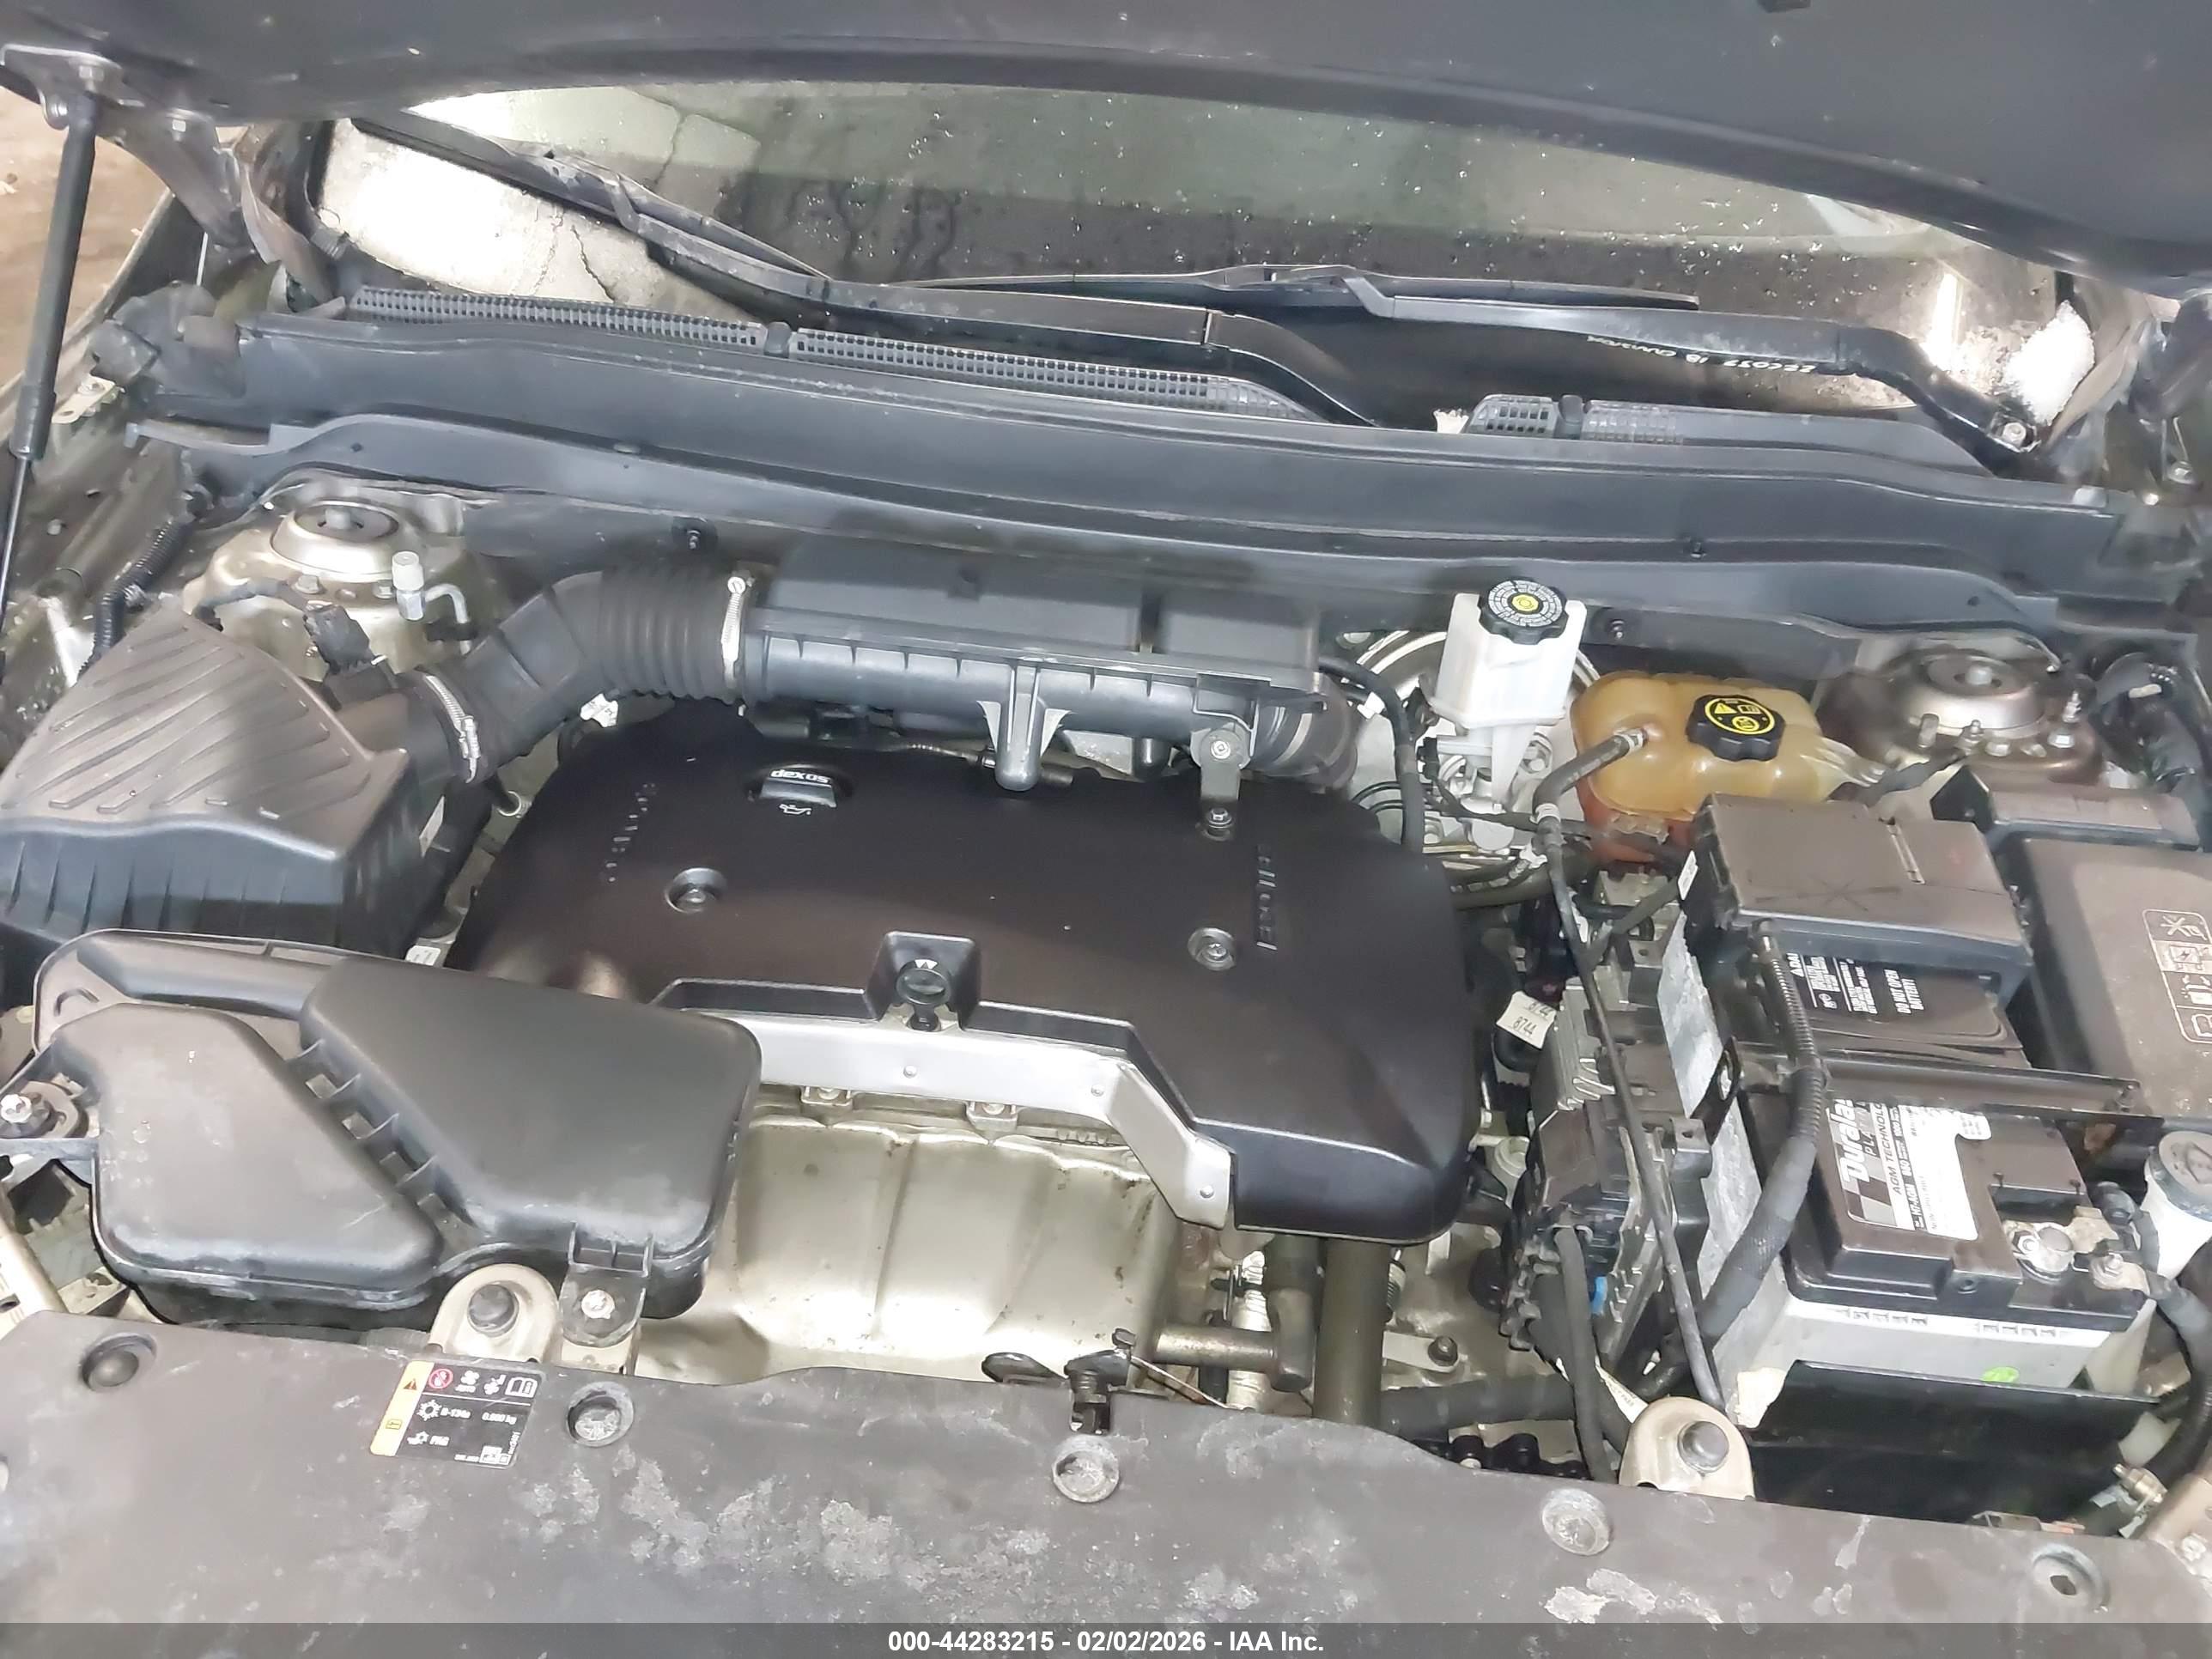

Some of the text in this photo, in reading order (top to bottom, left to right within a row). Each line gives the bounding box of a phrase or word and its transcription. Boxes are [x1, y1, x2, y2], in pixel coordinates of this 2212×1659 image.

[770, 769, 832, 784] dexos
[1884, 969, 1911, 1014] DO NOT OPEN
[1888, 1166, 1902, 1195] AGM
